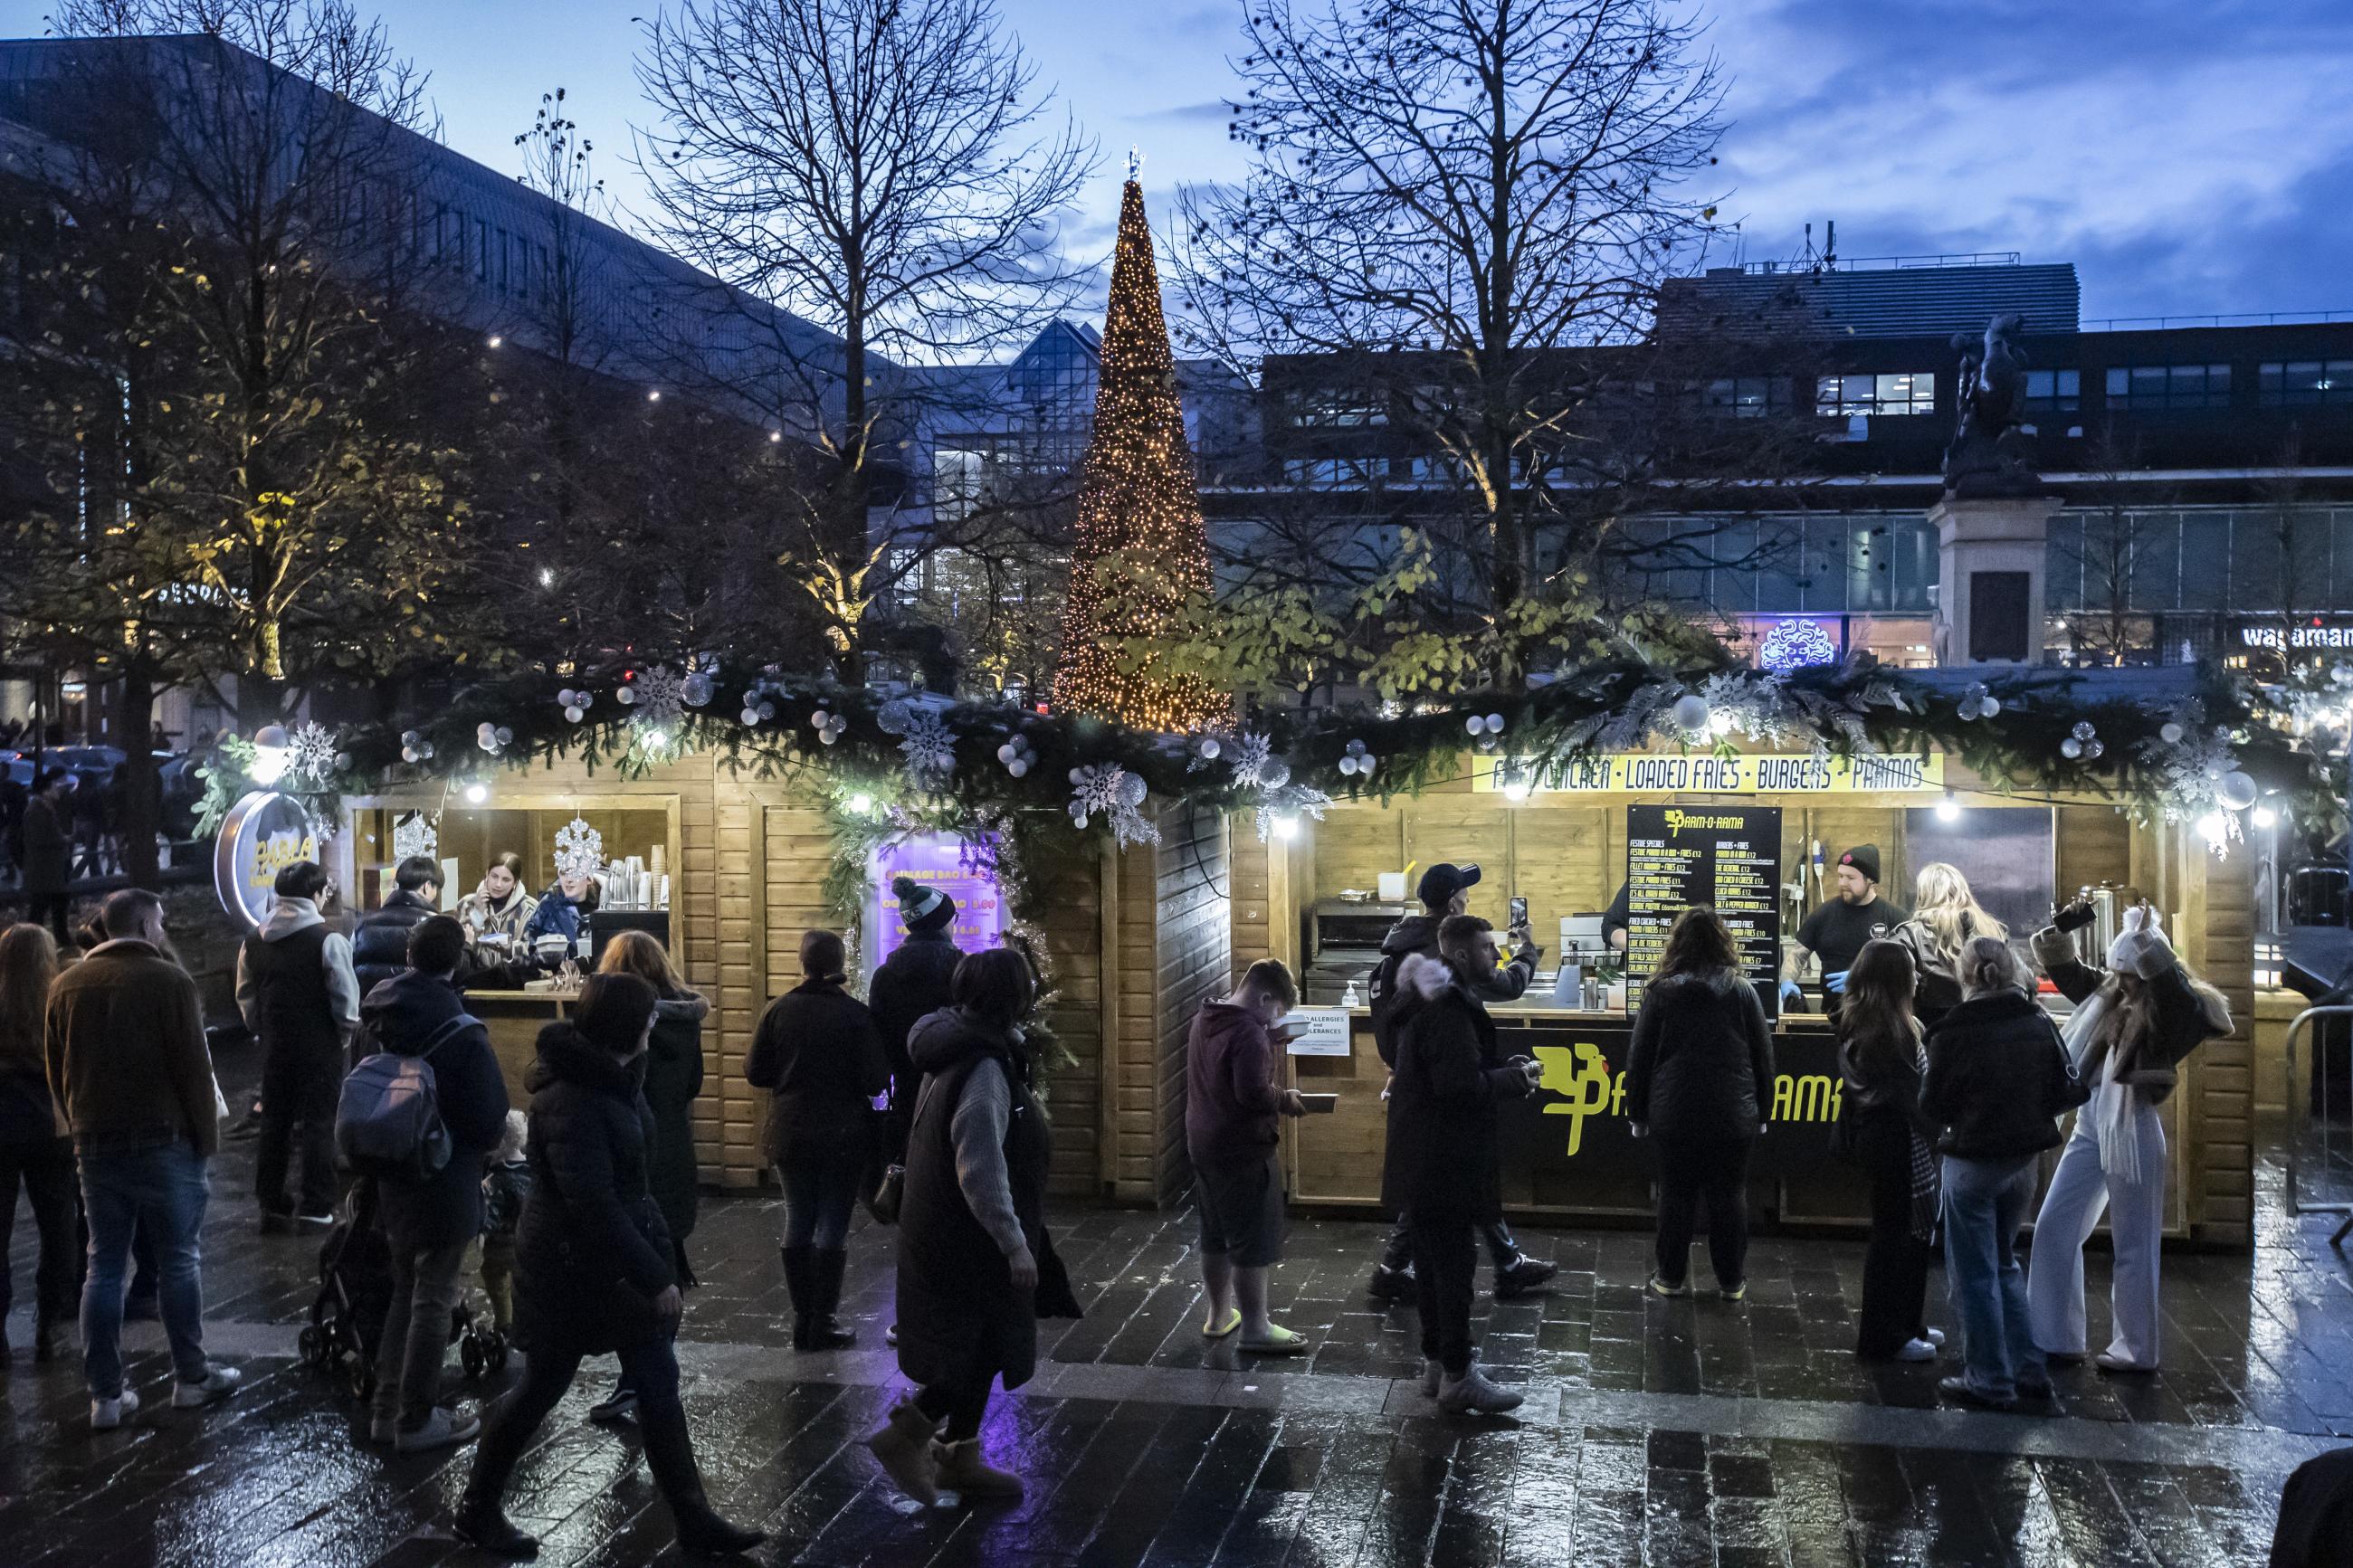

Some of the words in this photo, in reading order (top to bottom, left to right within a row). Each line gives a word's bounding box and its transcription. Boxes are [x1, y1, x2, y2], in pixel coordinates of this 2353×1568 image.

[1544, 759, 1610, 789] CICKEN
[1626, 760, 1688, 790] LOADED
[1692, 760, 1740, 789] FRIES
[1758, 759, 1831, 789] BURGERS
[1676, 864, 1686, 872] £12
